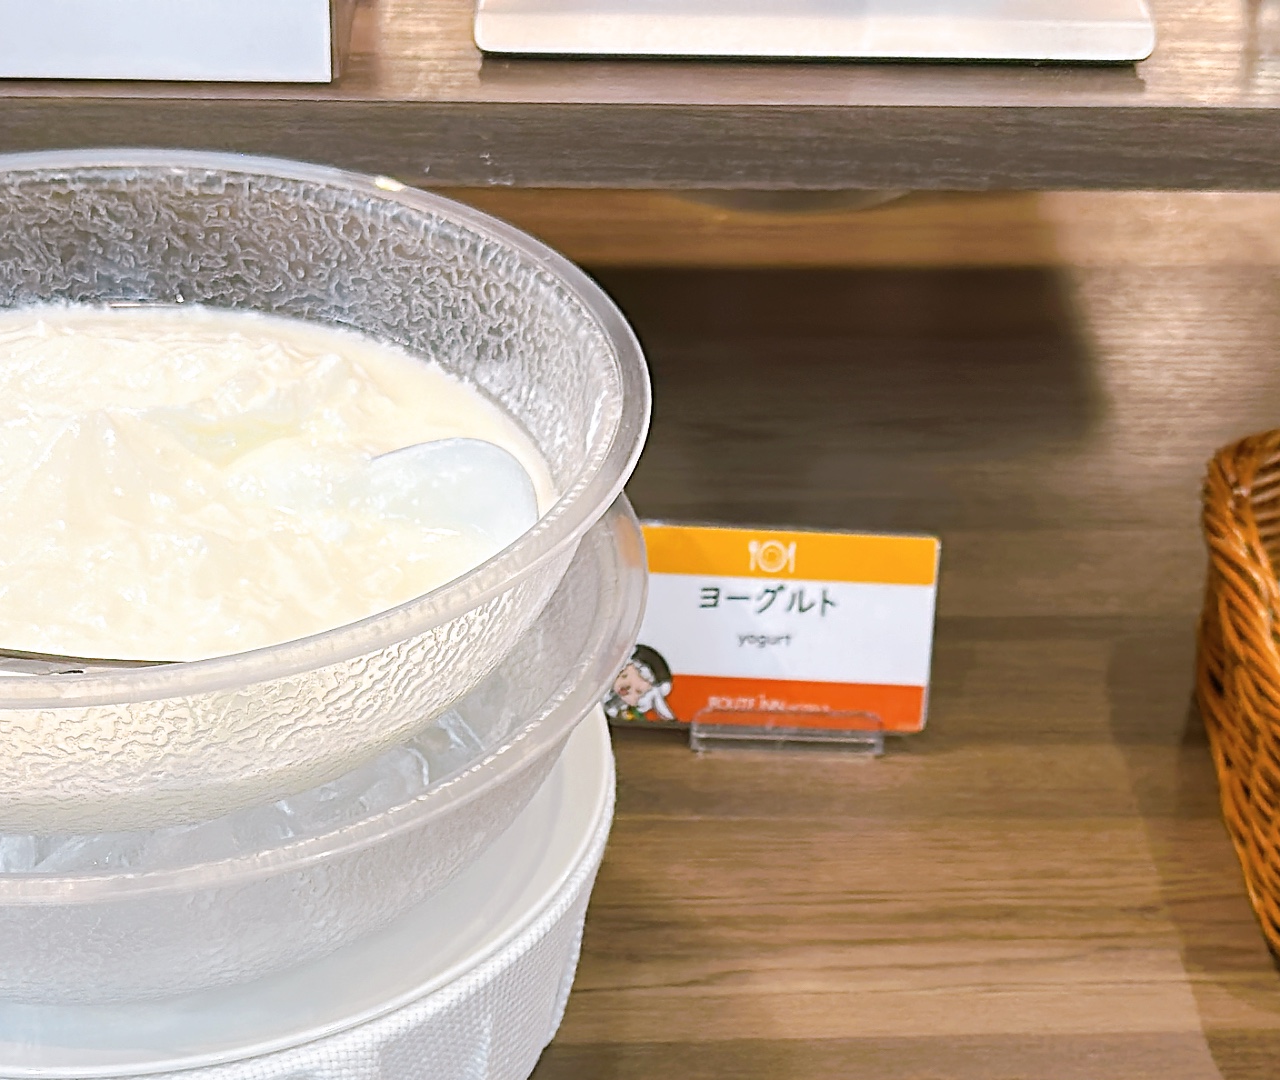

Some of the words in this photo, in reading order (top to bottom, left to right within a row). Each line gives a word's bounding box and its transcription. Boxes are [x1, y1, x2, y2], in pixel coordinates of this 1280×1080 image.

[699, 585, 837, 617] ヨーグルト
[738, 632, 792, 647] yogurt
